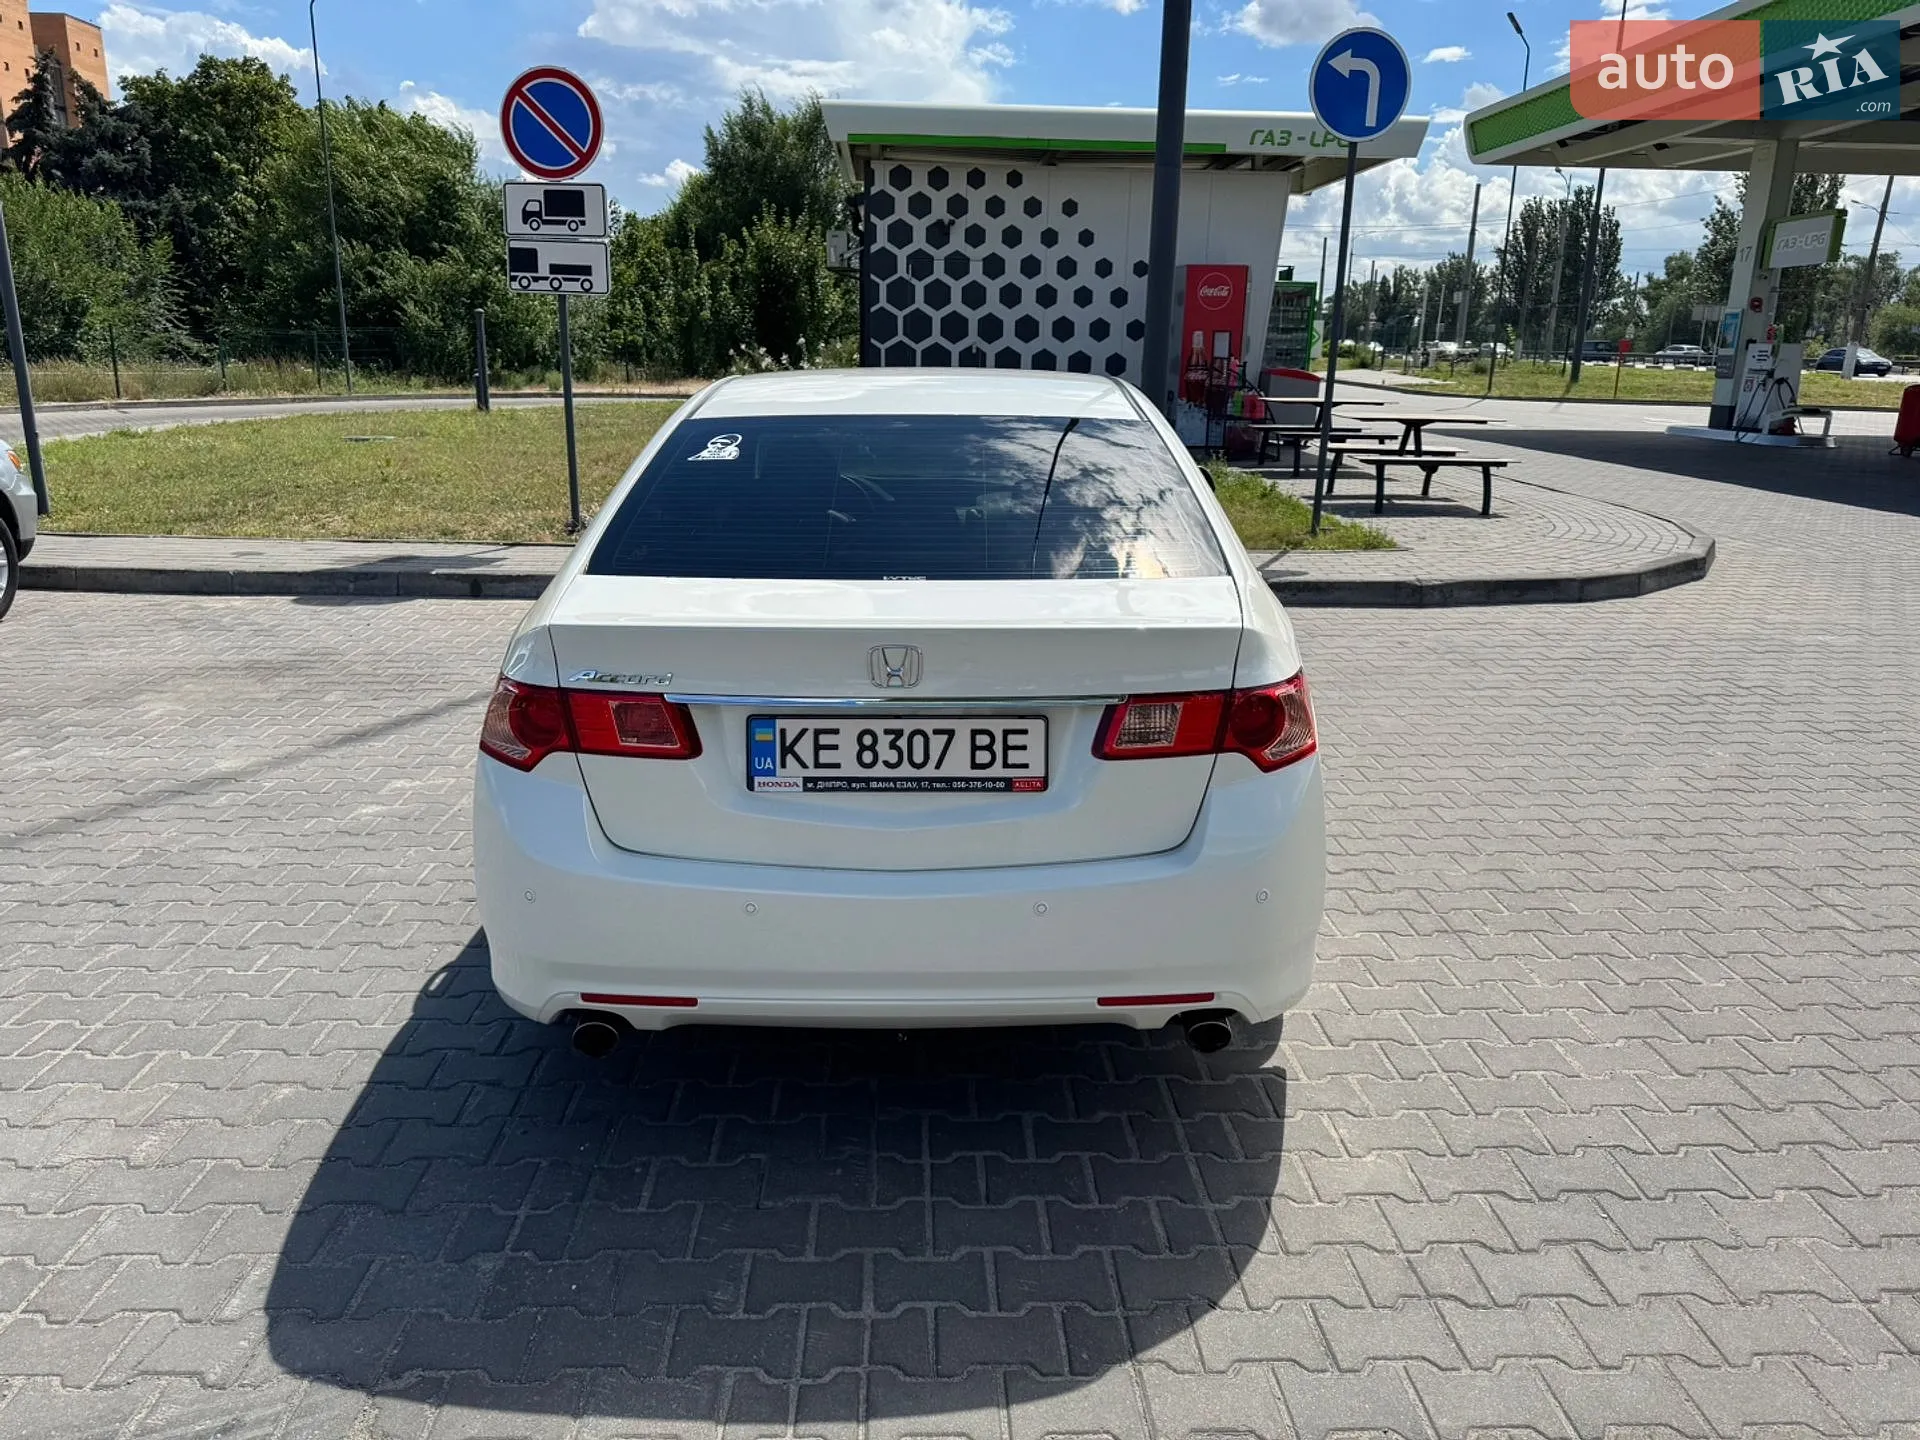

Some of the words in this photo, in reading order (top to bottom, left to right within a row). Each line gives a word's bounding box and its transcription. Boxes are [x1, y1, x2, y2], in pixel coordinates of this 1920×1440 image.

[1740, 246, 1752, 262] 17
[568, 669, 673, 686] Accord
[779, 728, 841, 770] KE
[856, 728, 956, 770] 8307
[970, 728, 1030, 770] BE
[754, 757, 774, 770] UA
